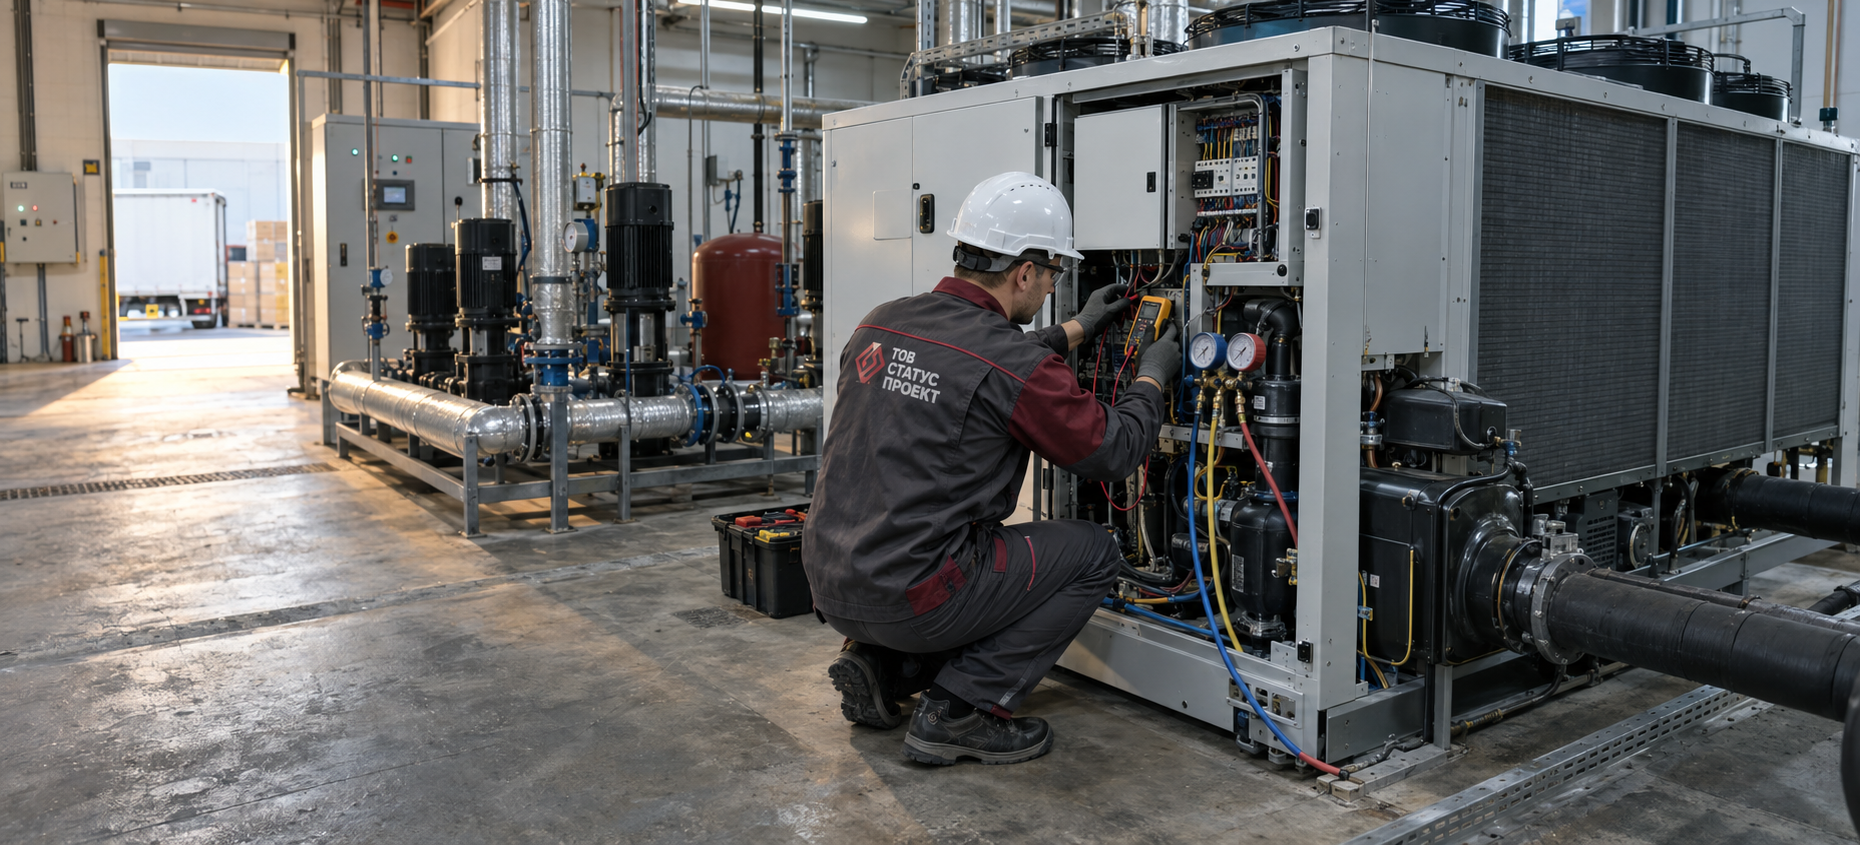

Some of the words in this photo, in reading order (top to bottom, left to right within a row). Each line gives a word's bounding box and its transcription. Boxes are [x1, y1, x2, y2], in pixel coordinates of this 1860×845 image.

[892, 347, 916, 364] ТОВ
[887, 362, 940, 387] СТАТУС
[882, 376, 941, 404] ПРОЕКТ
